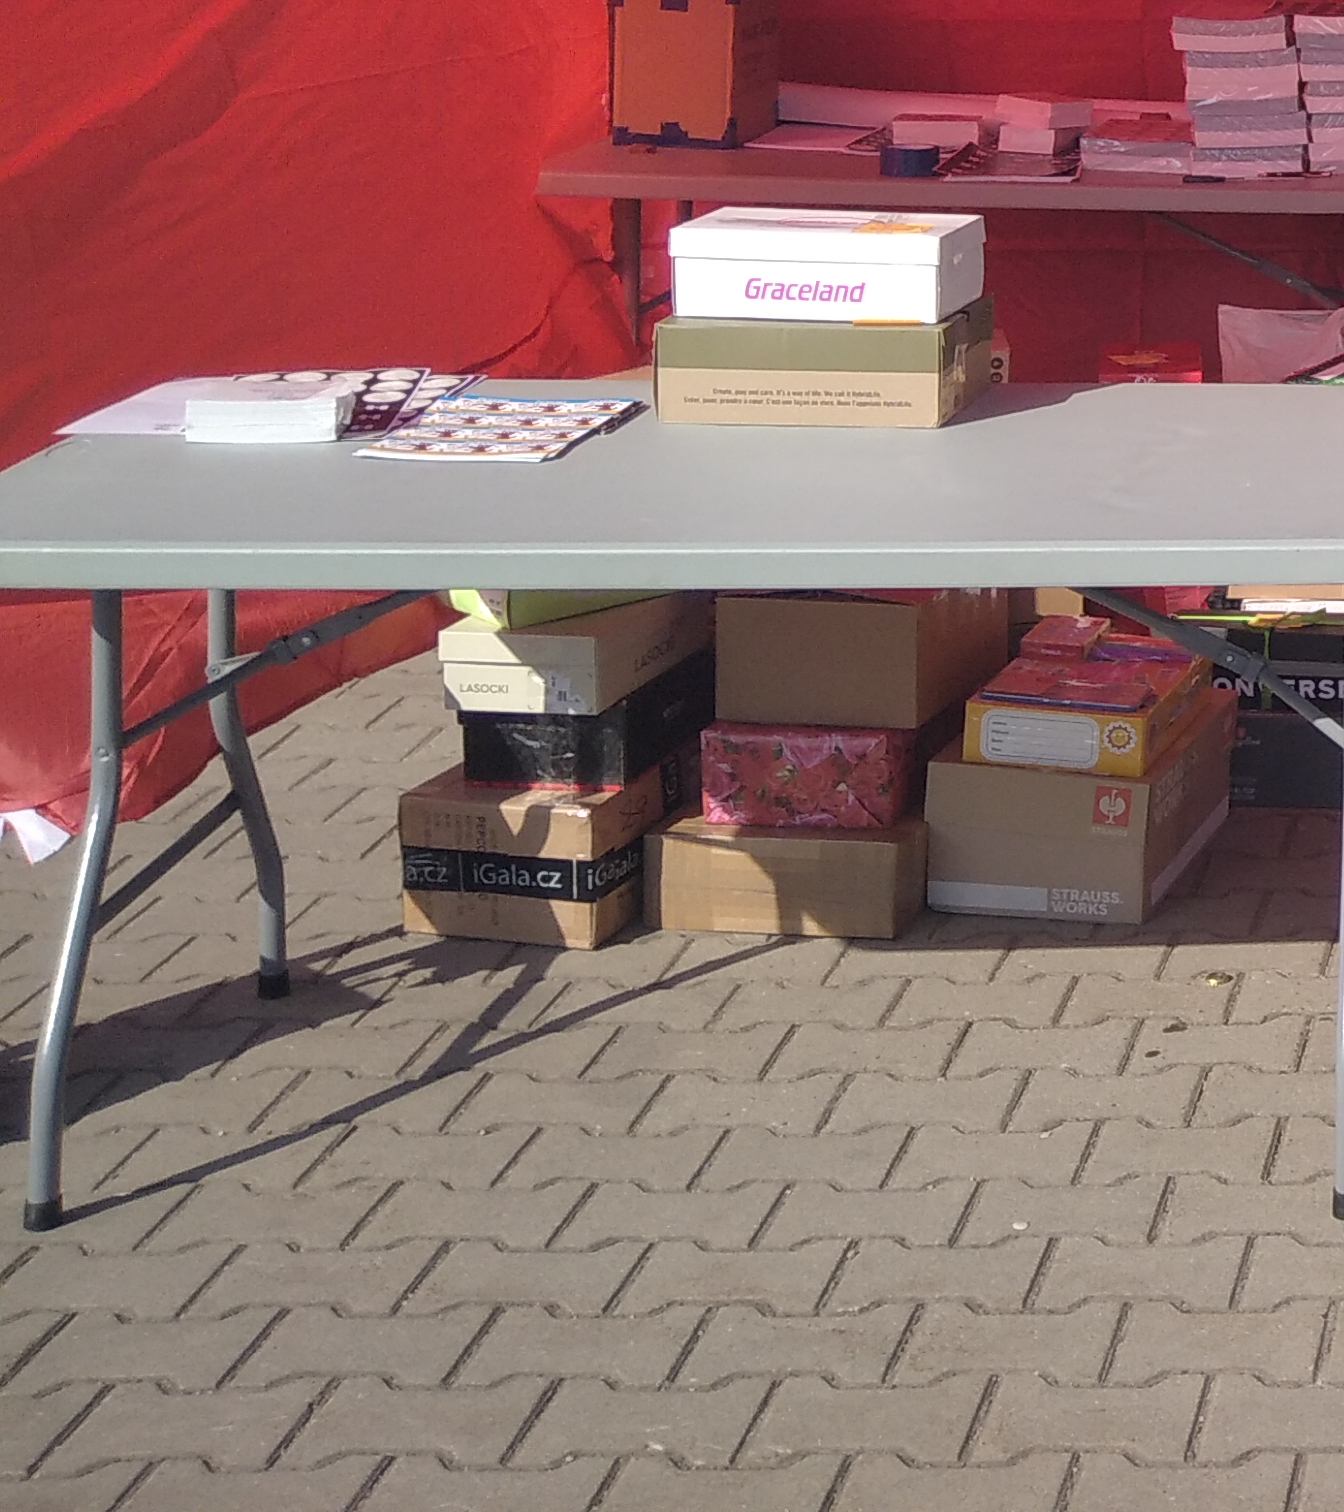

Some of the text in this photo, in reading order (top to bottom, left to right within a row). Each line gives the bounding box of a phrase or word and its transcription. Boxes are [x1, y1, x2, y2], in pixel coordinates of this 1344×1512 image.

[744, 277, 867, 303] Graceland
[458, 683, 510, 694] LASOCKI
[473, 864, 563, 889] iGala.cz
[1052, 900, 1108, 916] WORKS
